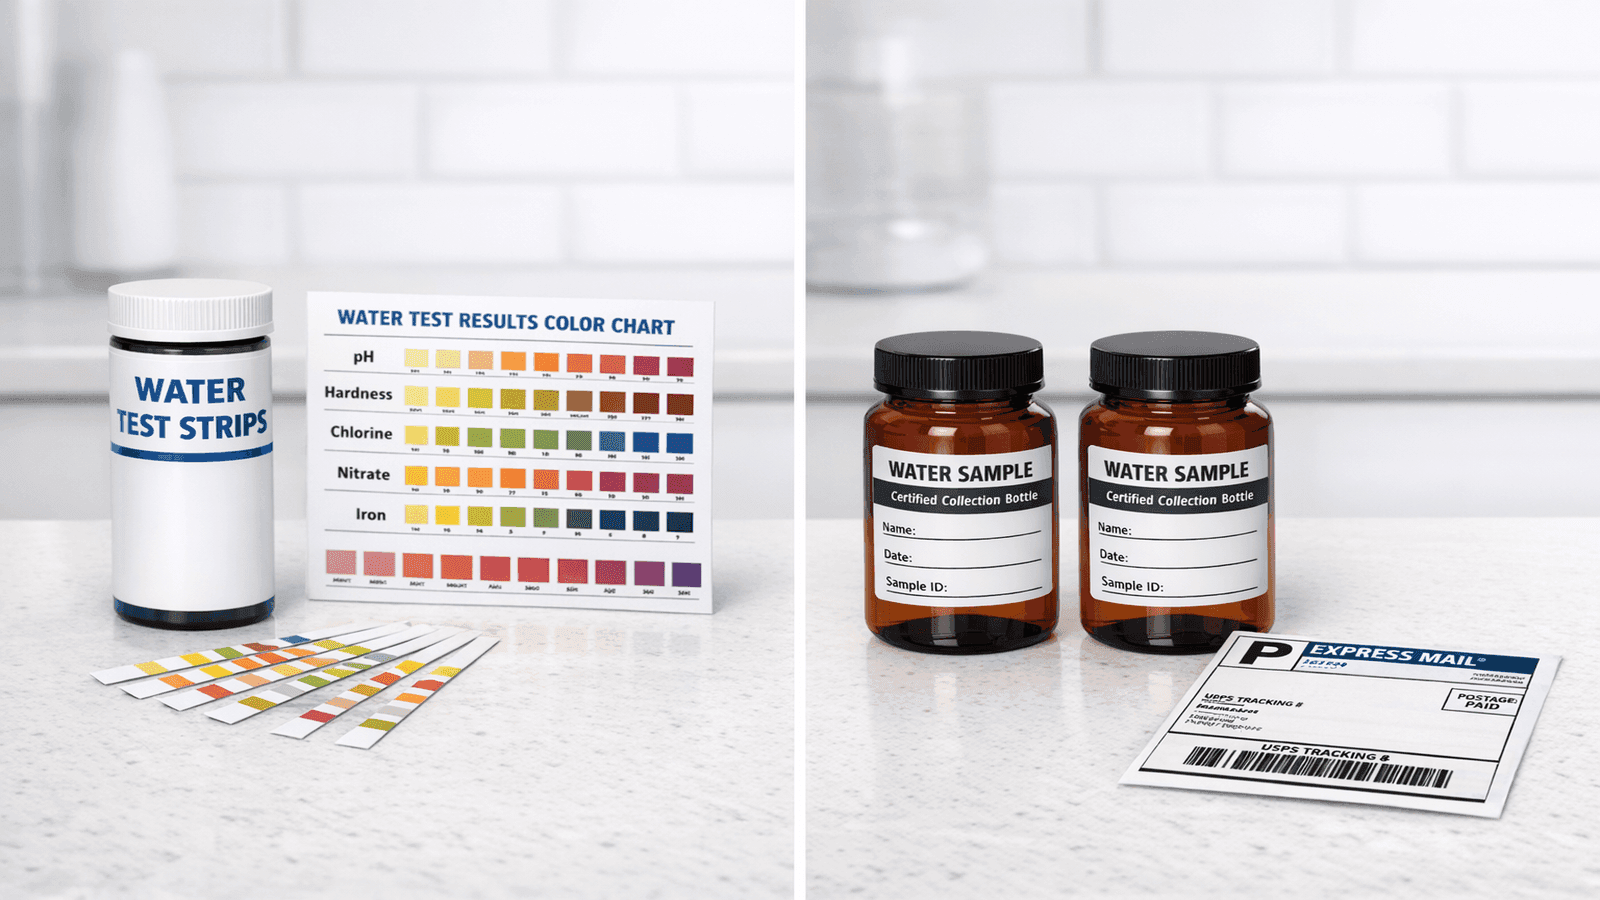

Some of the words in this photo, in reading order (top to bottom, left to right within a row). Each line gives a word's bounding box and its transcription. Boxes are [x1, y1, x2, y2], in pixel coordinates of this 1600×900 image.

[338, 310, 402, 325] WATER
[409, 311, 453, 327] TEST
[460, 313, 538, 329] RESULTS
[545, 315, 604, 332] COLOR
[612, 318, 675, 335] CHART
[354, 351, 373, 365] pH
[135, 377, 245, 403] WATER
[326, 386, 392, 400] Hardness
[117, 409, 170, 438] TEST
[180, 409, 267, 440] STRIPS
[331, 426, 392, 439] Chlorine
[338, 467, 390, 480] Nitrate
[888, 460, 951, 482] WATER
[958, 461, 1033, 482] SAMPLE
[1104, 460, 1168, 482] WATER
[1174, 461, 1249, 482] SAMPLE
[891, 491, 938, 505] Certified
[942, 496, 1000, 506] Collection
[1006, 491, 1037, 503] Bottle
[1106, 491, 1154, 505] Certified
[1158, 495, 1216, 506] Collection
[1222, 491, 1253, 503] Bottle
[357, 508, 385, 520] Iron
[882, 521, 916, 536] Name:
[1098, 521, 1132, 536] Name:
[884, 548, 912, 562] Date:
[1100, 548, 1128, 562] Date:
[886, 576, 927, 592] Sample
[931, 582, 947, 592] ID:
[1102, 576, 1143, 592] Sample
[1147, 582, 1163, 591] ID:
[1240, 640, 1294, 664] P
[1310, 644, 1414, 661] EXPRESS
[1236, 697, 1292, 706] TRACKING
[1465, 700, 1501, 709] PAID
[1261, 743, 1300, 753] USPS
[1303, 748, 1377, 760] TRACKING
